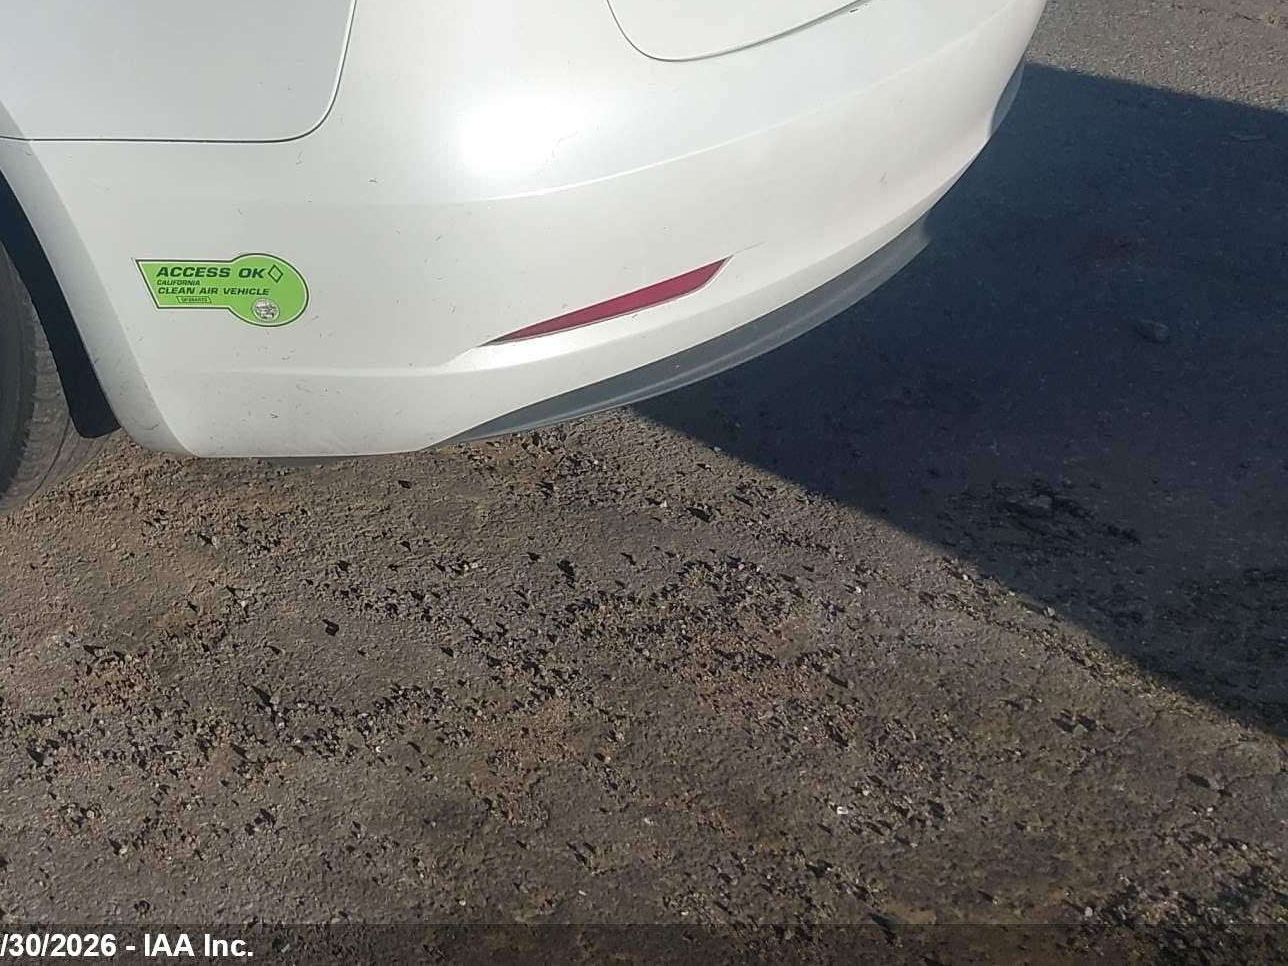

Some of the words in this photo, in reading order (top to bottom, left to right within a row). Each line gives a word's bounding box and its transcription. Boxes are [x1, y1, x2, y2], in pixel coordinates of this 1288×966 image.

[156, 266, 231, 278] ACCESS
[238, 267, 265, 278] OK
[158, 286, 195, 294] CLEAN
[199, 286, 218, 294] AIR
[223, 287, 270, 295] VEHICLE
